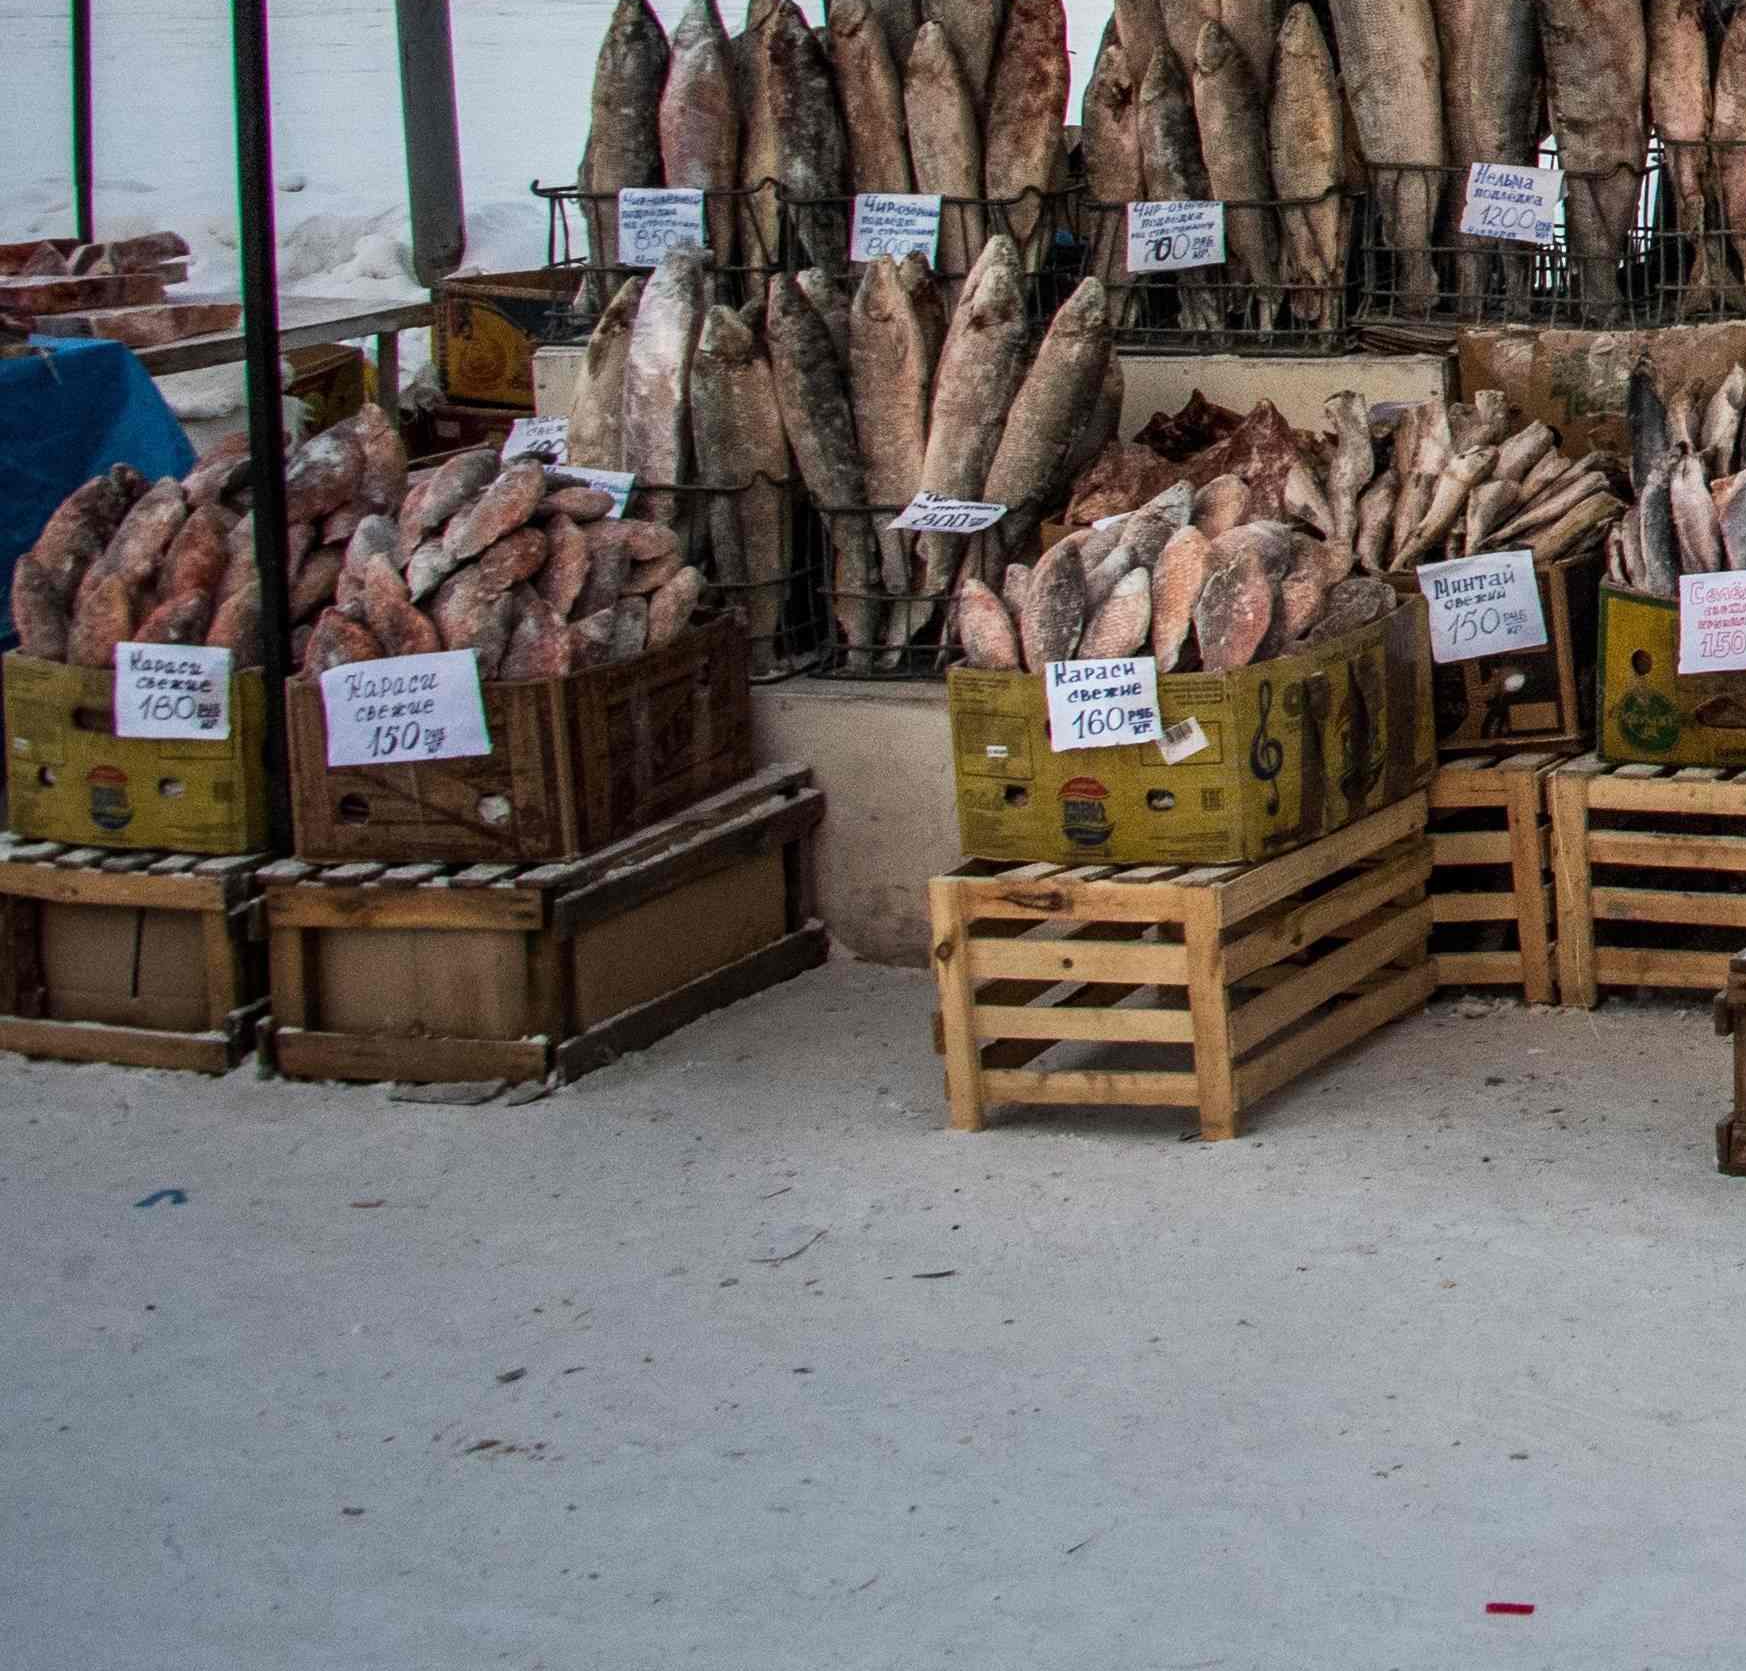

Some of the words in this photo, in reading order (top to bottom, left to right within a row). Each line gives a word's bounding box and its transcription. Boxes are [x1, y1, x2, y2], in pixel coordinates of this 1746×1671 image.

[1481, 206, 1536, 229] 1200
[634, 229, 676, 250] 850
[866, 237, 912, 257] 800
[1143, 233, 1190, 264] 700
[1434, 563, 1515, 600] Минтай
[1447, 607, 1501, 645] 150
[1700, 630, 1746, 658] 150
[129, 649, 205, 676] Караси
[1054, 661, 1137, 687] Караси
[136, 676, 211, 693] свежие
[345, 671, 439, 701] Караси
[1067, 682, 1143, 704] свежие
[139, 694, 197, 721] 180
[355, 698, 435, 723] свежие
[1072, 706, 1126, 740] 160
[366, 720, 421, 758] 150
